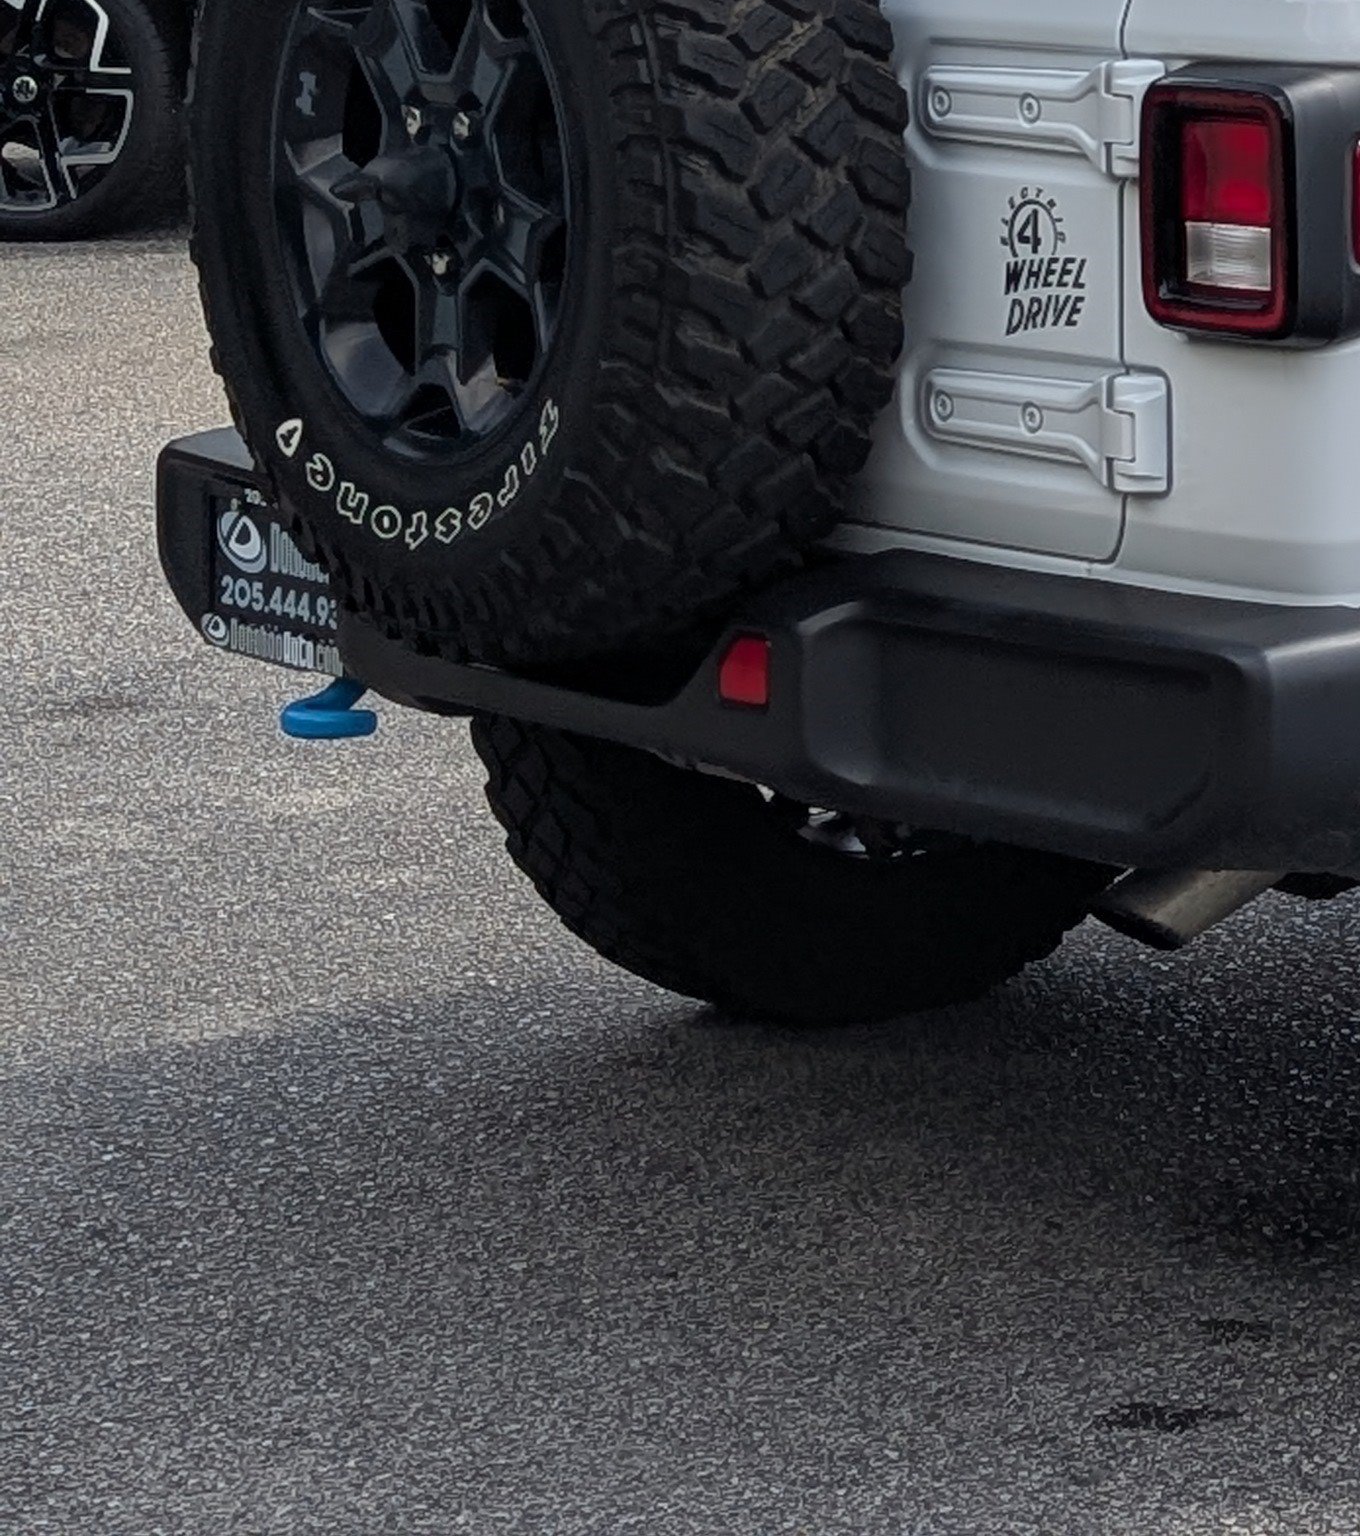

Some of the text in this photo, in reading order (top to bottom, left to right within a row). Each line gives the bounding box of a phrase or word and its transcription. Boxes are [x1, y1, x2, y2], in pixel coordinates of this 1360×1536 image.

[1017, 208, 1041, 254] 4
[1004, 257, 1087, 295] WHEEL
[1005, 294, 1085, 336] DRIVE
